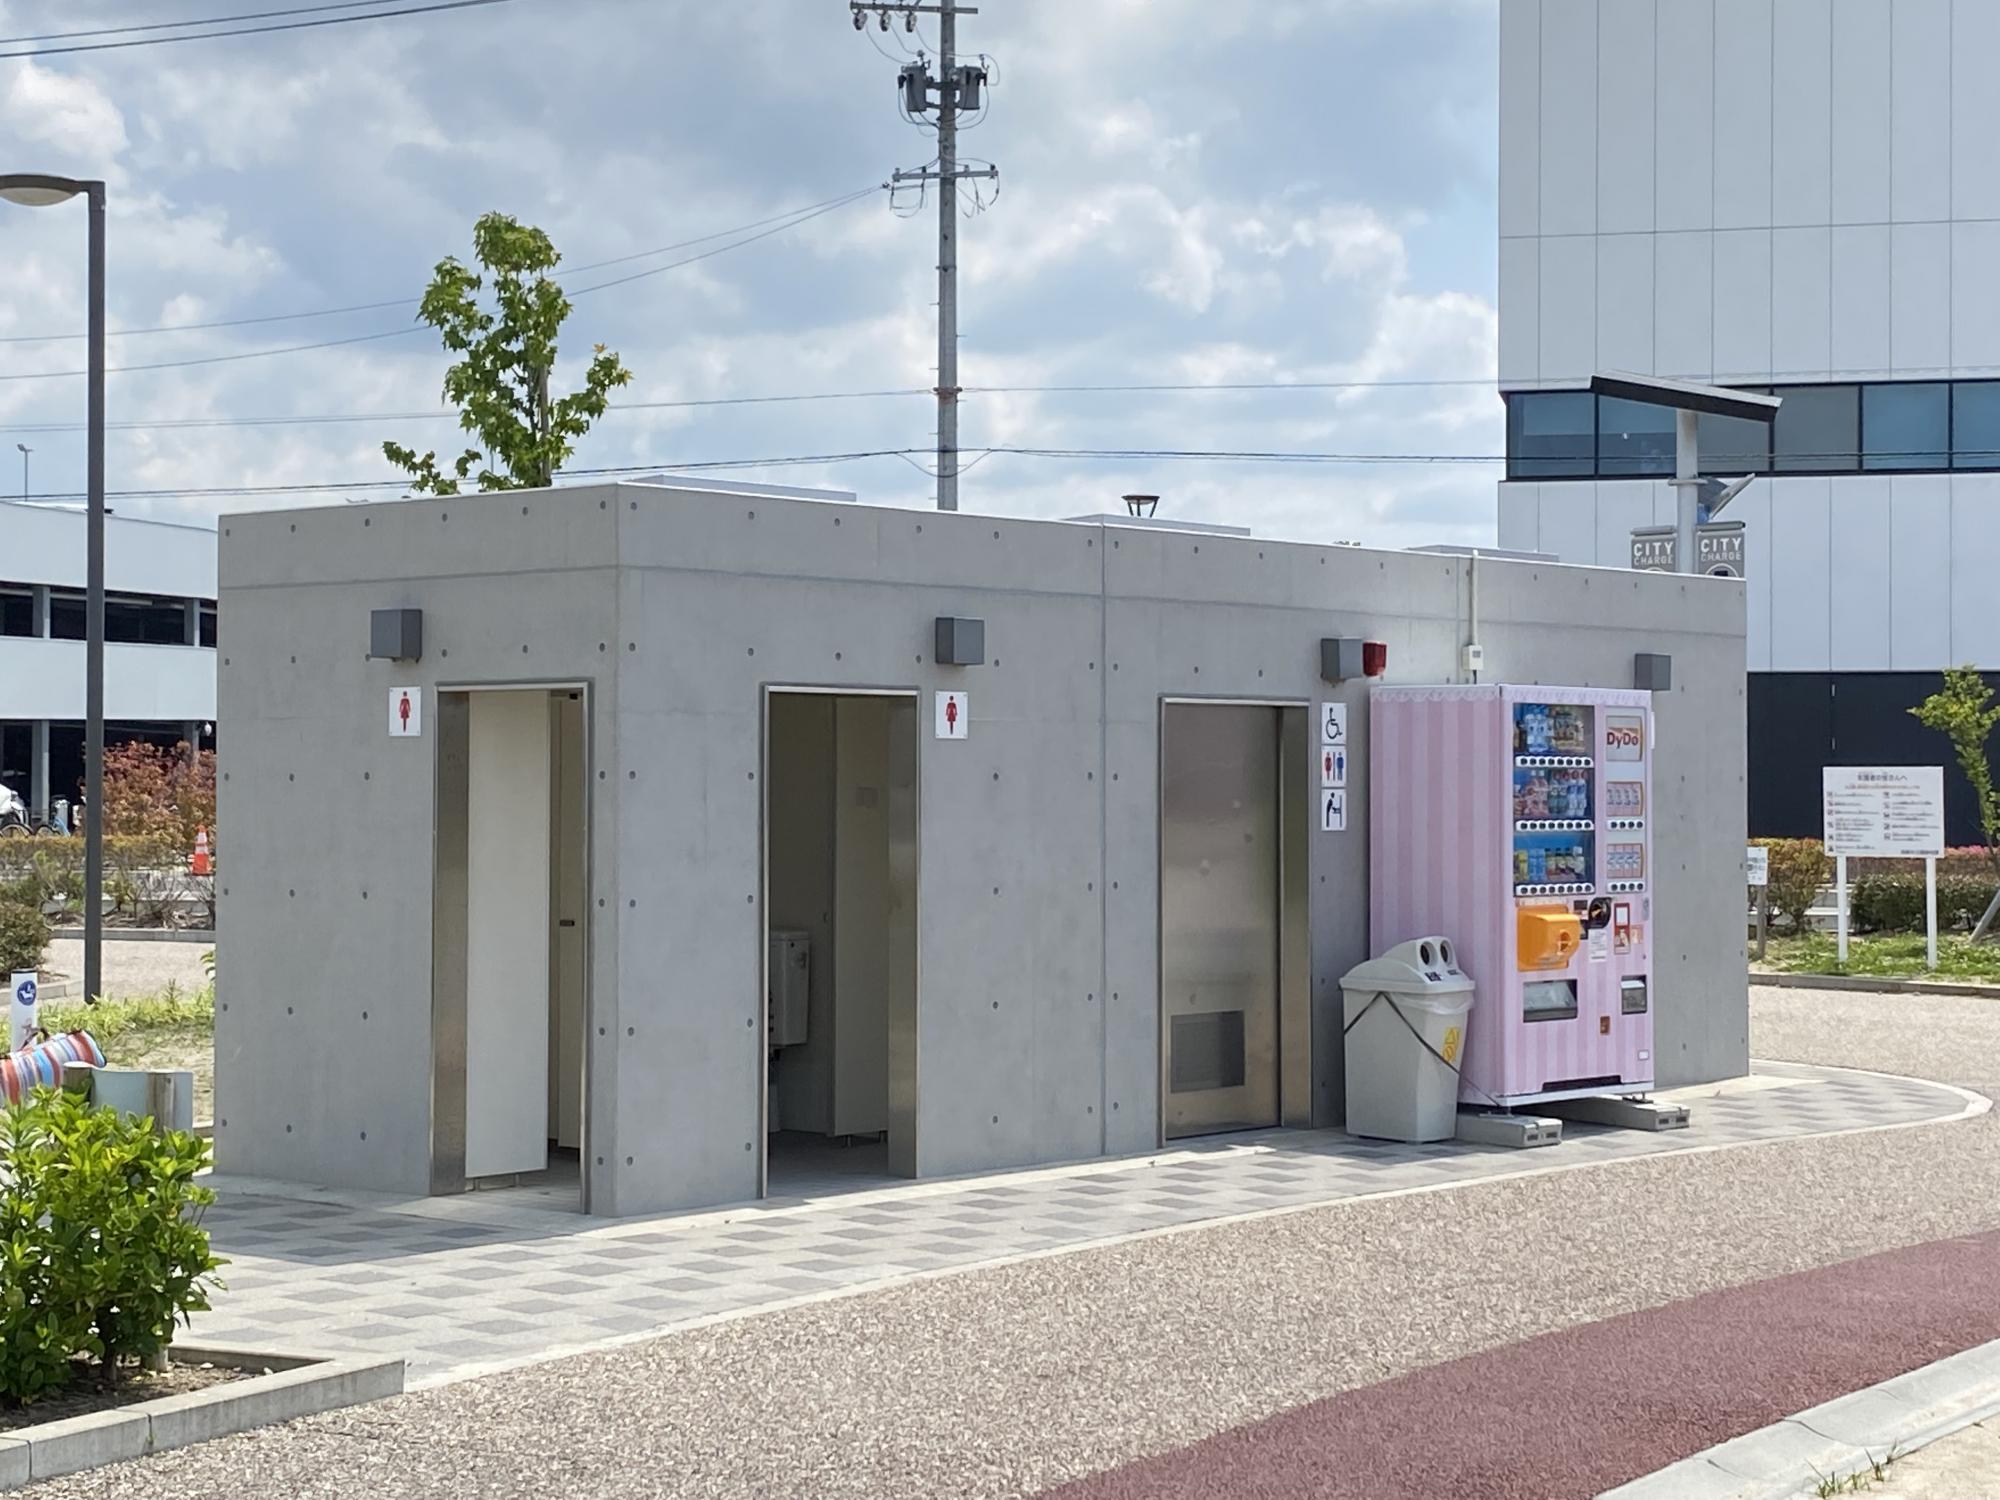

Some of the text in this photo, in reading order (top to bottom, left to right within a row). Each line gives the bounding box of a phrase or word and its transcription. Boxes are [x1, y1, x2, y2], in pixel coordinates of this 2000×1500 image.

[1634, 541, 1674, 556] CITY
[1701, 537, 1742, 552] CITY
[1634, 555, 1673, 565] CHARGE
[1701, 551, 1742, 561] CHARGE
[1607, 731, 1639, 749] DyDo
